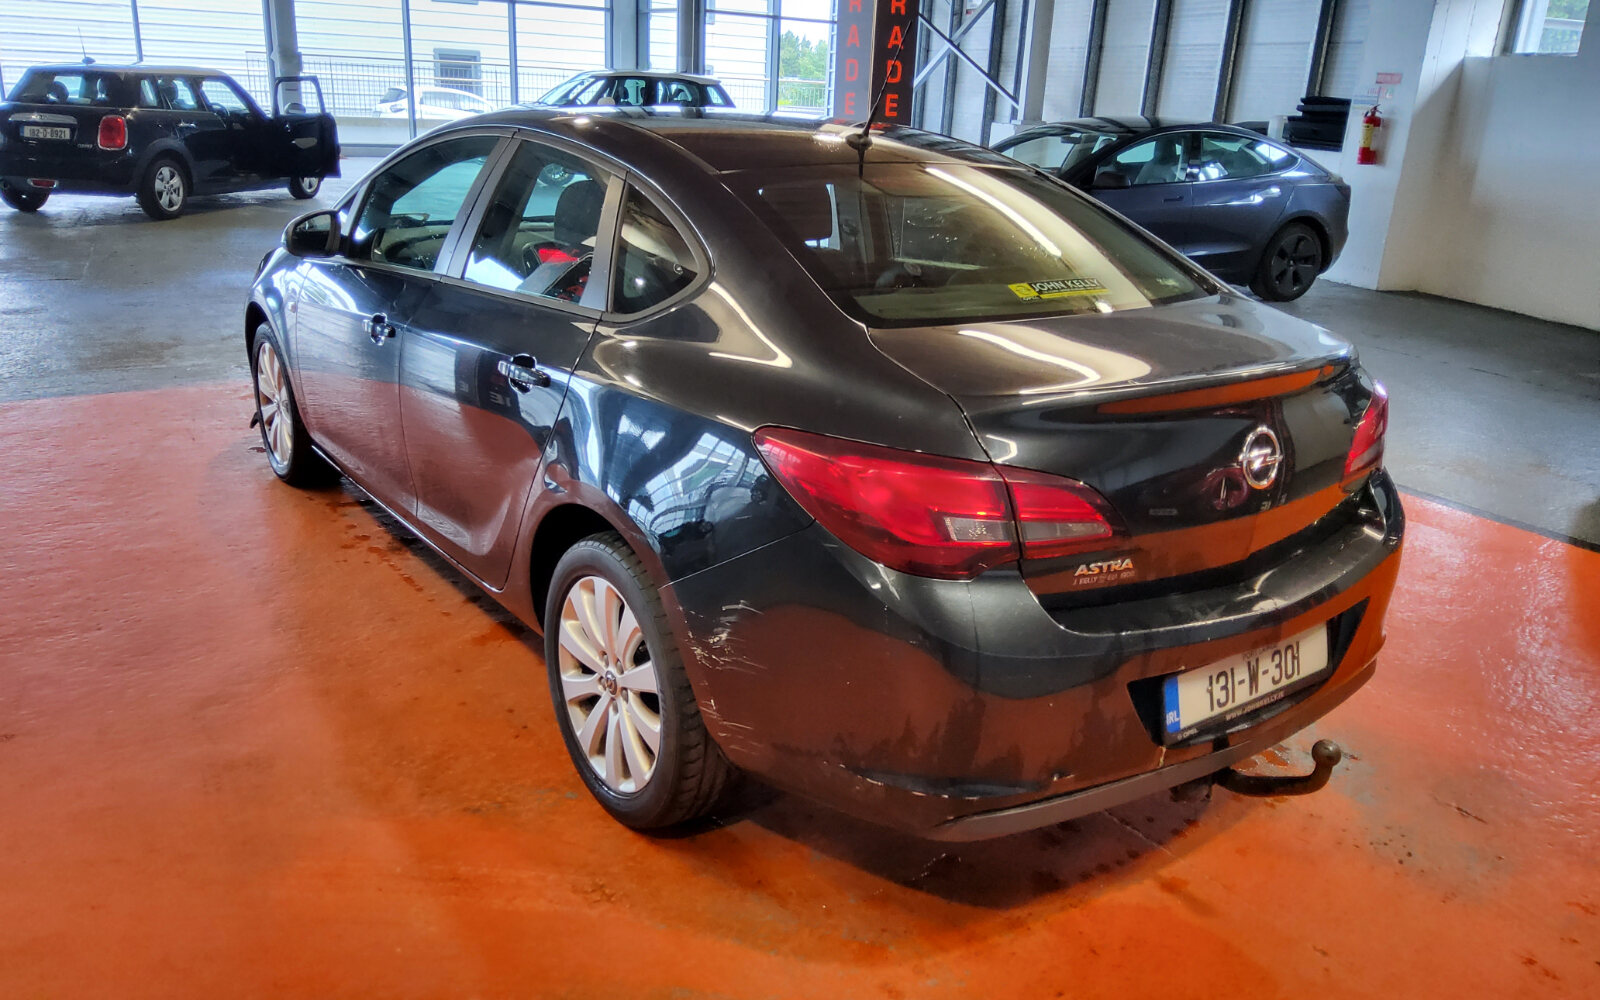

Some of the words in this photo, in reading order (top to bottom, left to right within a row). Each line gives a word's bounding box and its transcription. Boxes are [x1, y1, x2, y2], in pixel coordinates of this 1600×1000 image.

[1031, 280, 1067, 292] JOHN
[1065, 278, 1100, 289] KELLY
[1074, 558, 1134, 576] ASTRA
[1206, 641, 1300, 712] 131-W-301
[1166, 710, 1180, 725] IRL
